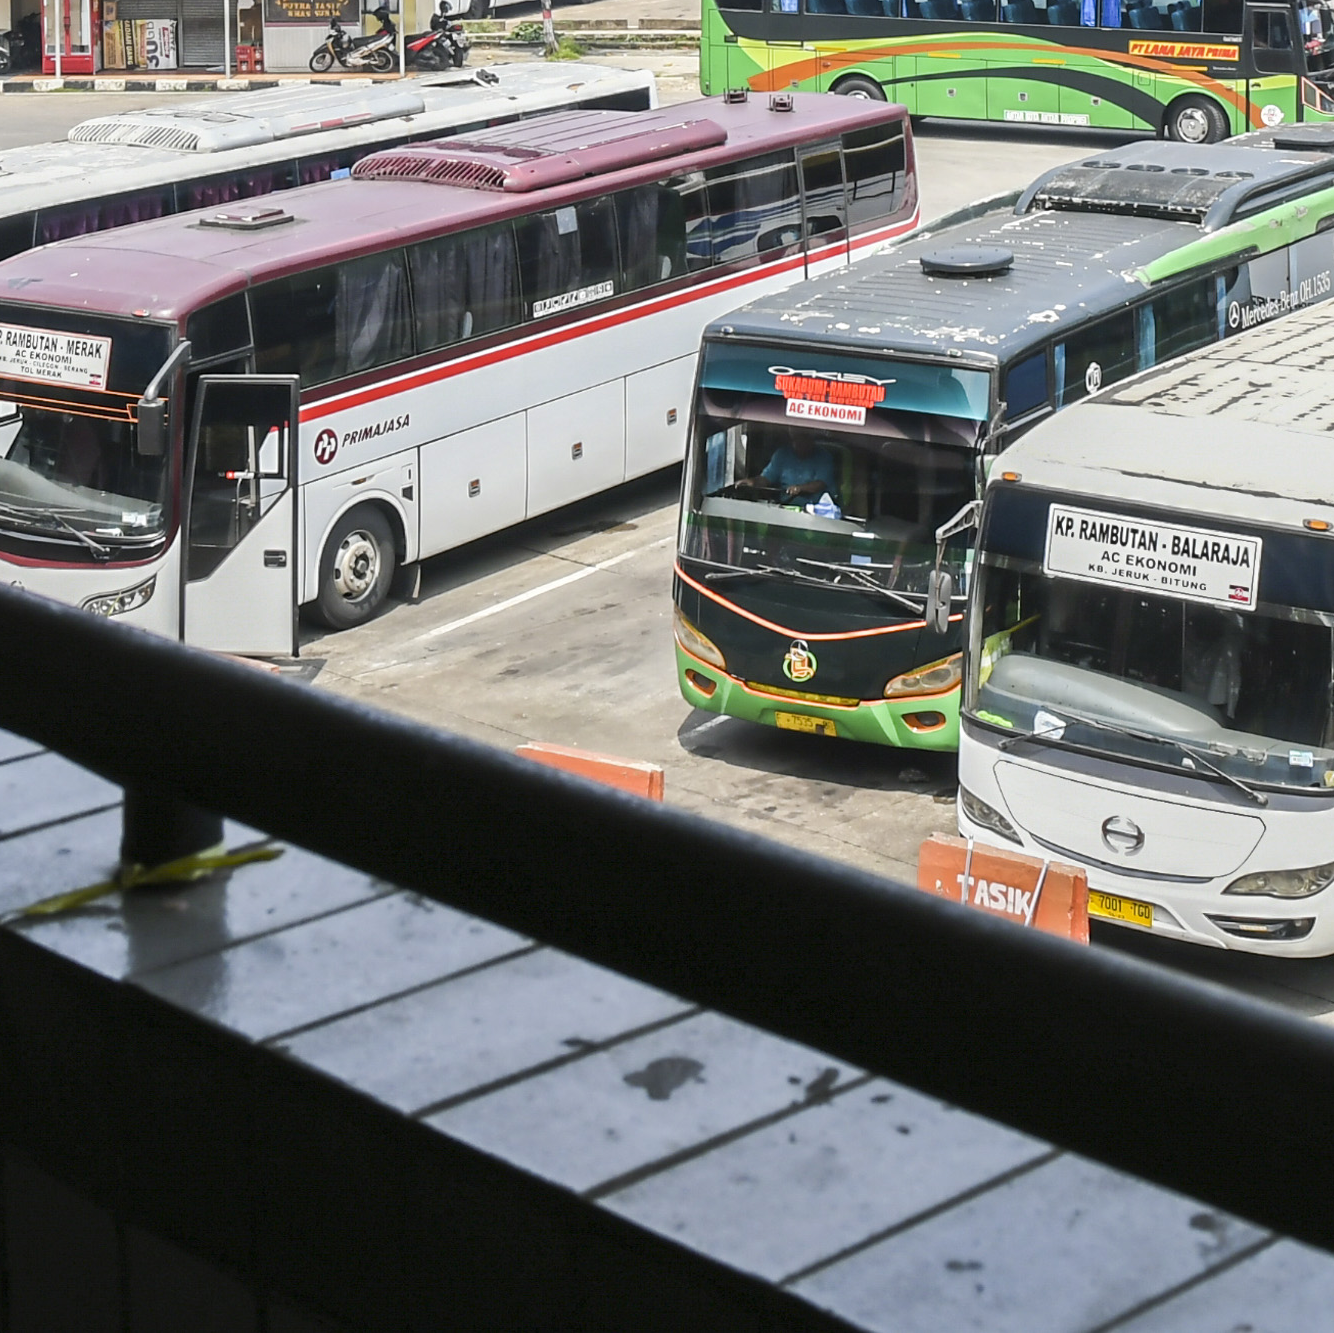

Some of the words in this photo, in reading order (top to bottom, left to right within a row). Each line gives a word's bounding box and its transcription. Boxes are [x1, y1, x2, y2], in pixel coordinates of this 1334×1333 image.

[1241, 290, 1299, 329] Mercedes-Benz
[6, 331, 58, 352] RAMBUTAN
[66, 339, 103, 359] MERAK
[15, 349, 26, 357] AC
[29, 351, 72, 364] EKONOMI
[21, 366, 33, 374] TOL
[36, 368, 62, 378] MERAK
[789, 402, 804, 414] AC
[808, 407, 861, 421] EKONOMI
[342, 414, 409, 448] PRIMAJASA
[1055, 514, 1075, 537] KP.
[1079, 519, 1158, 552] RAMBUTAN
[1171, 535, 1250, 568] BALARAJA
[1101, 550, 1120, 563] AC
[1125, 554, 1197, 577] EKONOMI
[1088, 564, 1107, 574] KB.
[1112, 568, 1150, 582] JERUK
[1161, 576, 1207, 591] BITUNG
[957, 874, 1033, 918] TASIK
[1099, 894, 1121, 912] 7001
